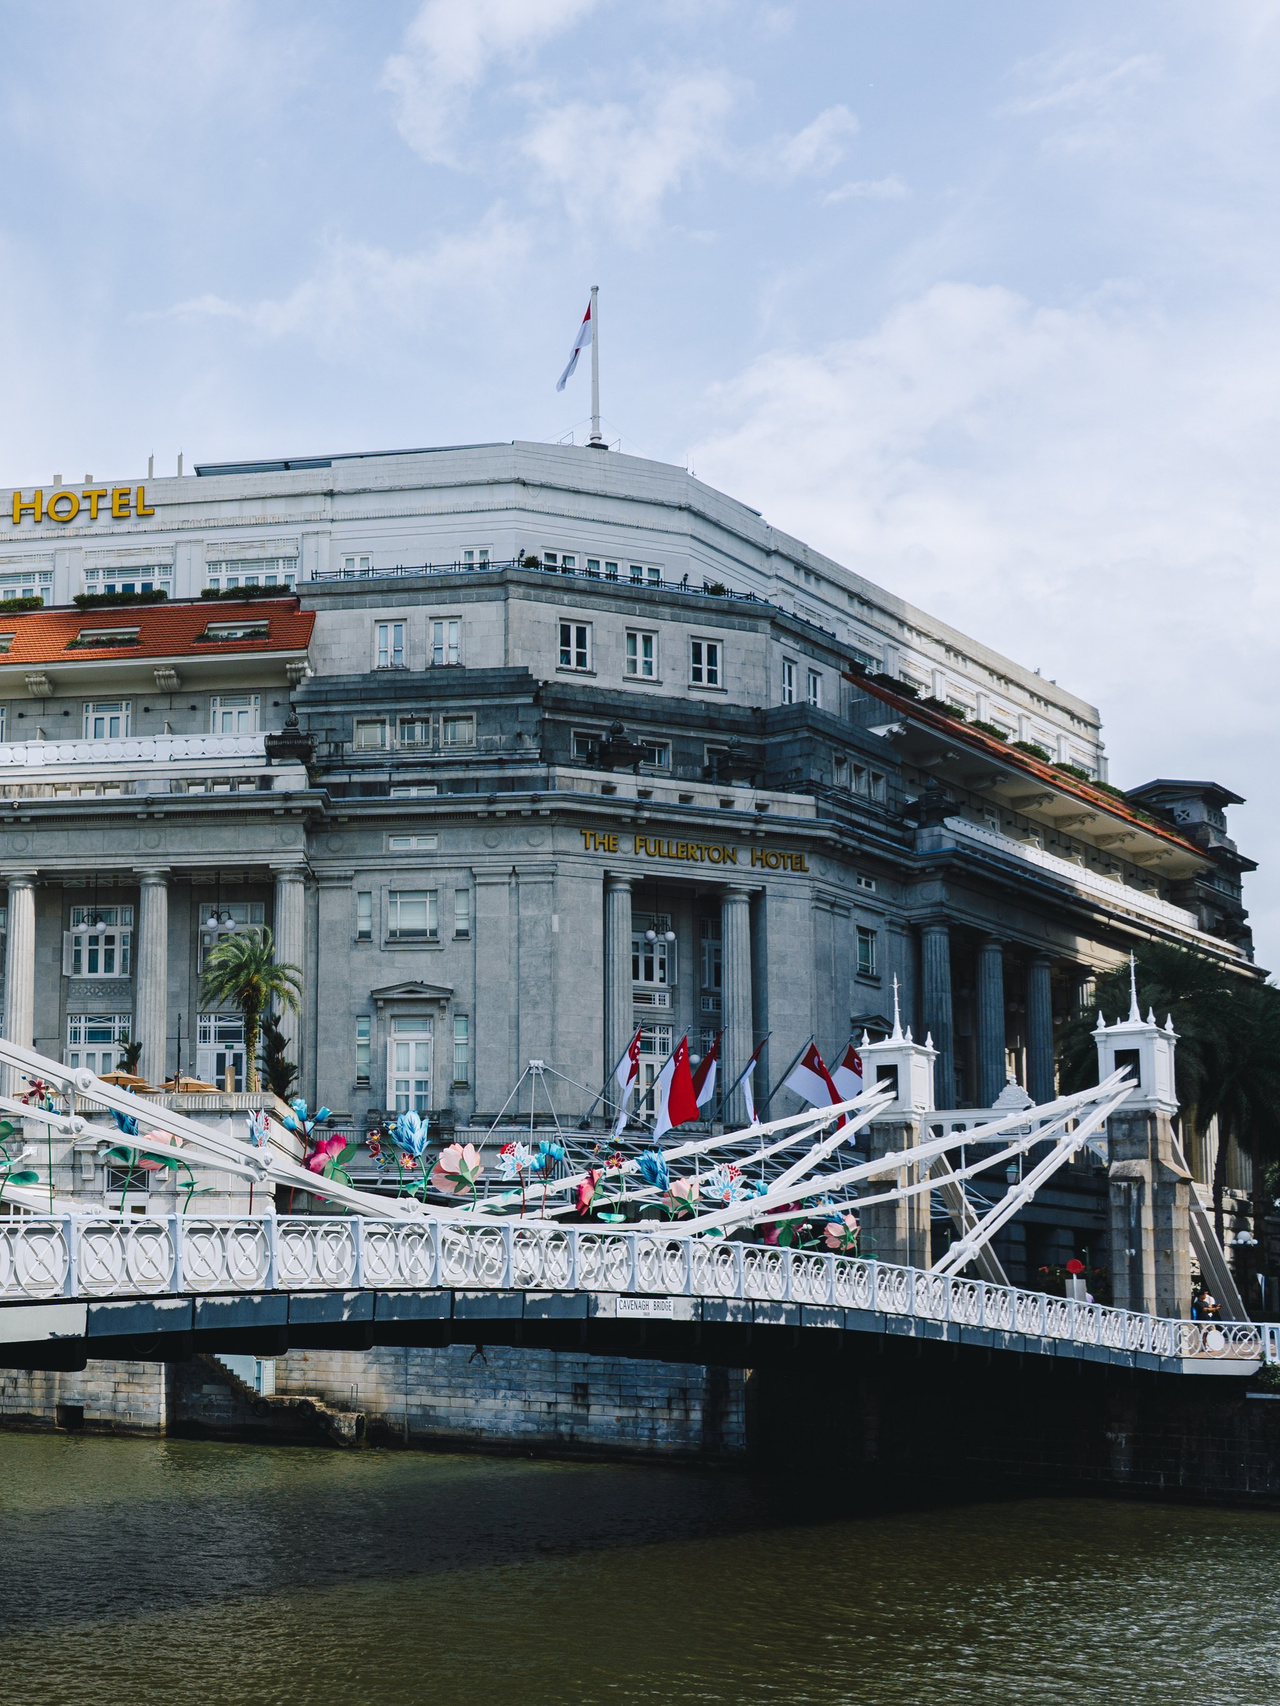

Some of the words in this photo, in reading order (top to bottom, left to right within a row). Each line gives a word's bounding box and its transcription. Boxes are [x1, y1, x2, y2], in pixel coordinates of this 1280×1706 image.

[12, 486, 155, 524] HOTEL
[580, 829, 618, 852] THE
[634, 835, 737, 864] FULLERTON
[751, 847, 809, 871] HOTEL
[619, 1300, 649, 1310] CAVENAGH
[653, 1301, 672, 1311] BRIDGE
